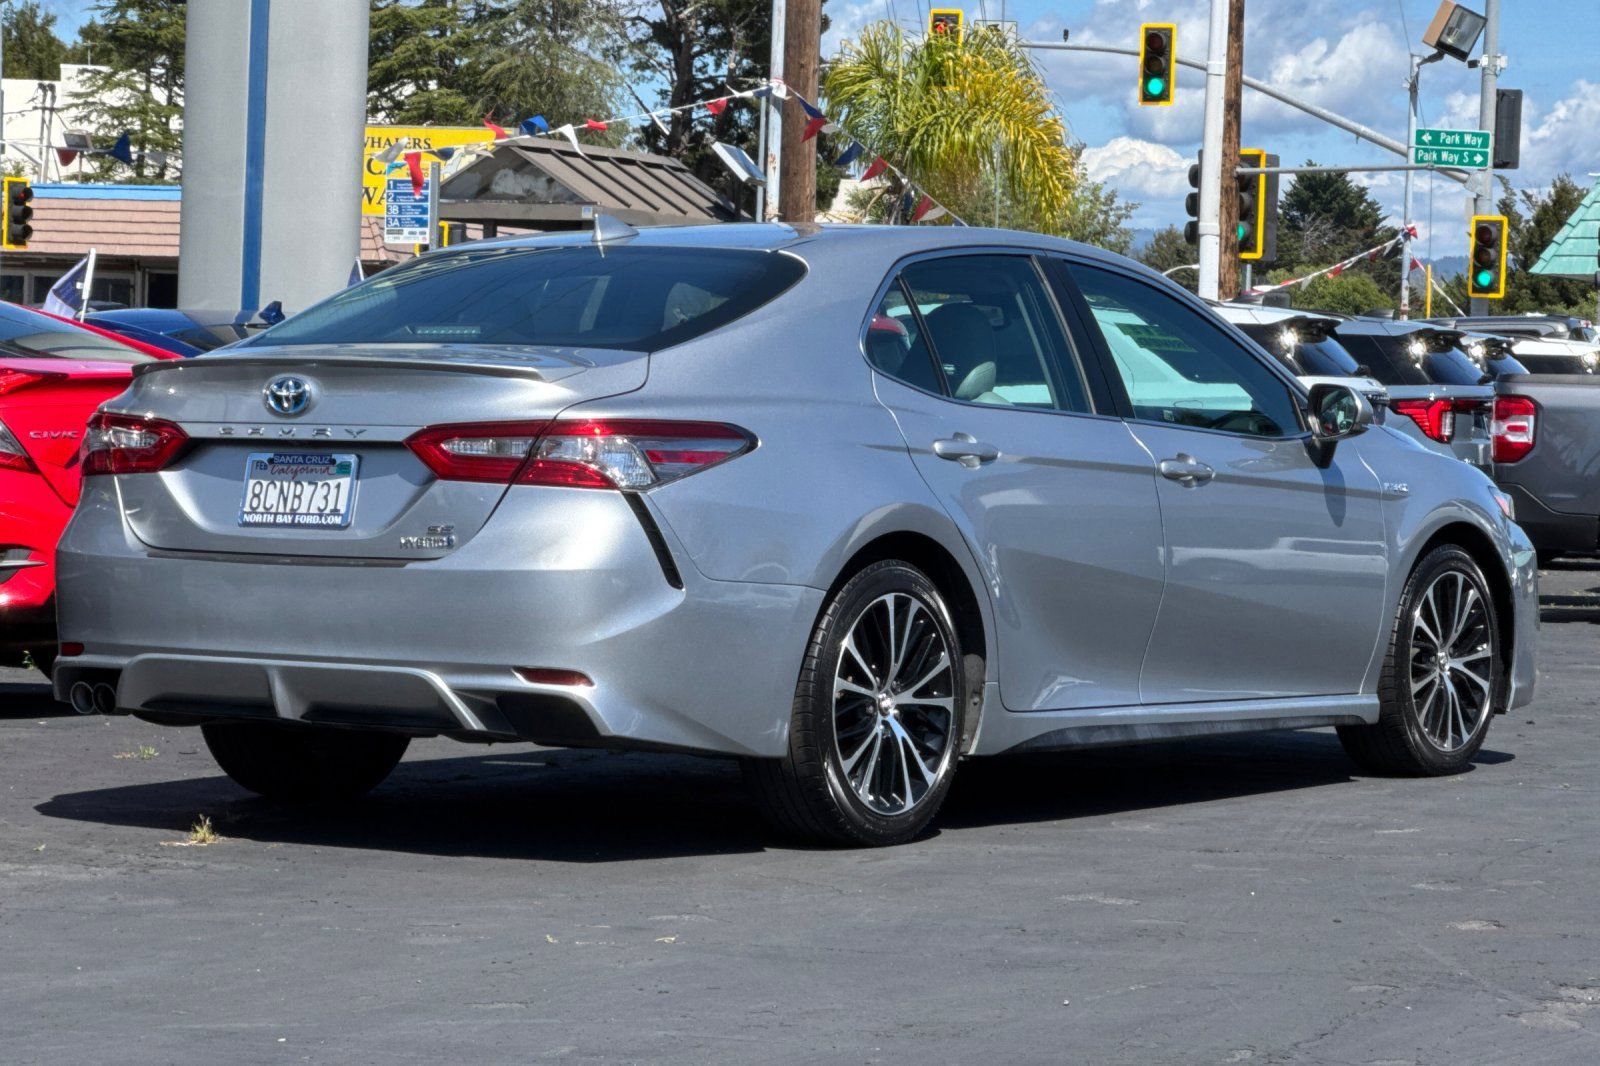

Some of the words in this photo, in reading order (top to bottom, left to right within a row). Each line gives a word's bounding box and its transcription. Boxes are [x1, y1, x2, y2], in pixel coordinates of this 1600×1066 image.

[1440, 132, 1460, 145] Park
[1464, 133, 1483, 148] Way
[1417, 149, 1438, 161] Park
[1441, 151, 1460, 164] Way
[1463, 151, 1470, 163] S
[389, 180, 394, 190] 1
[387, 192, 394, 202] 2
[387, 204, 399, 215] 3B
[387, 217, 400, 228] 3A
[29, 430, 79, 439] CIVIC
[273, 455, 302, 464] SANTA
[305, 455, 331, 465] CRUZ
[270, 463, 336, 480] California
[249, 480, 342, 514] 8CNB731
[243, 513, 274, 523] NORTH
[275, 514, 294, 524] BAY
[295, 514, 342, 525] FORD.COM
